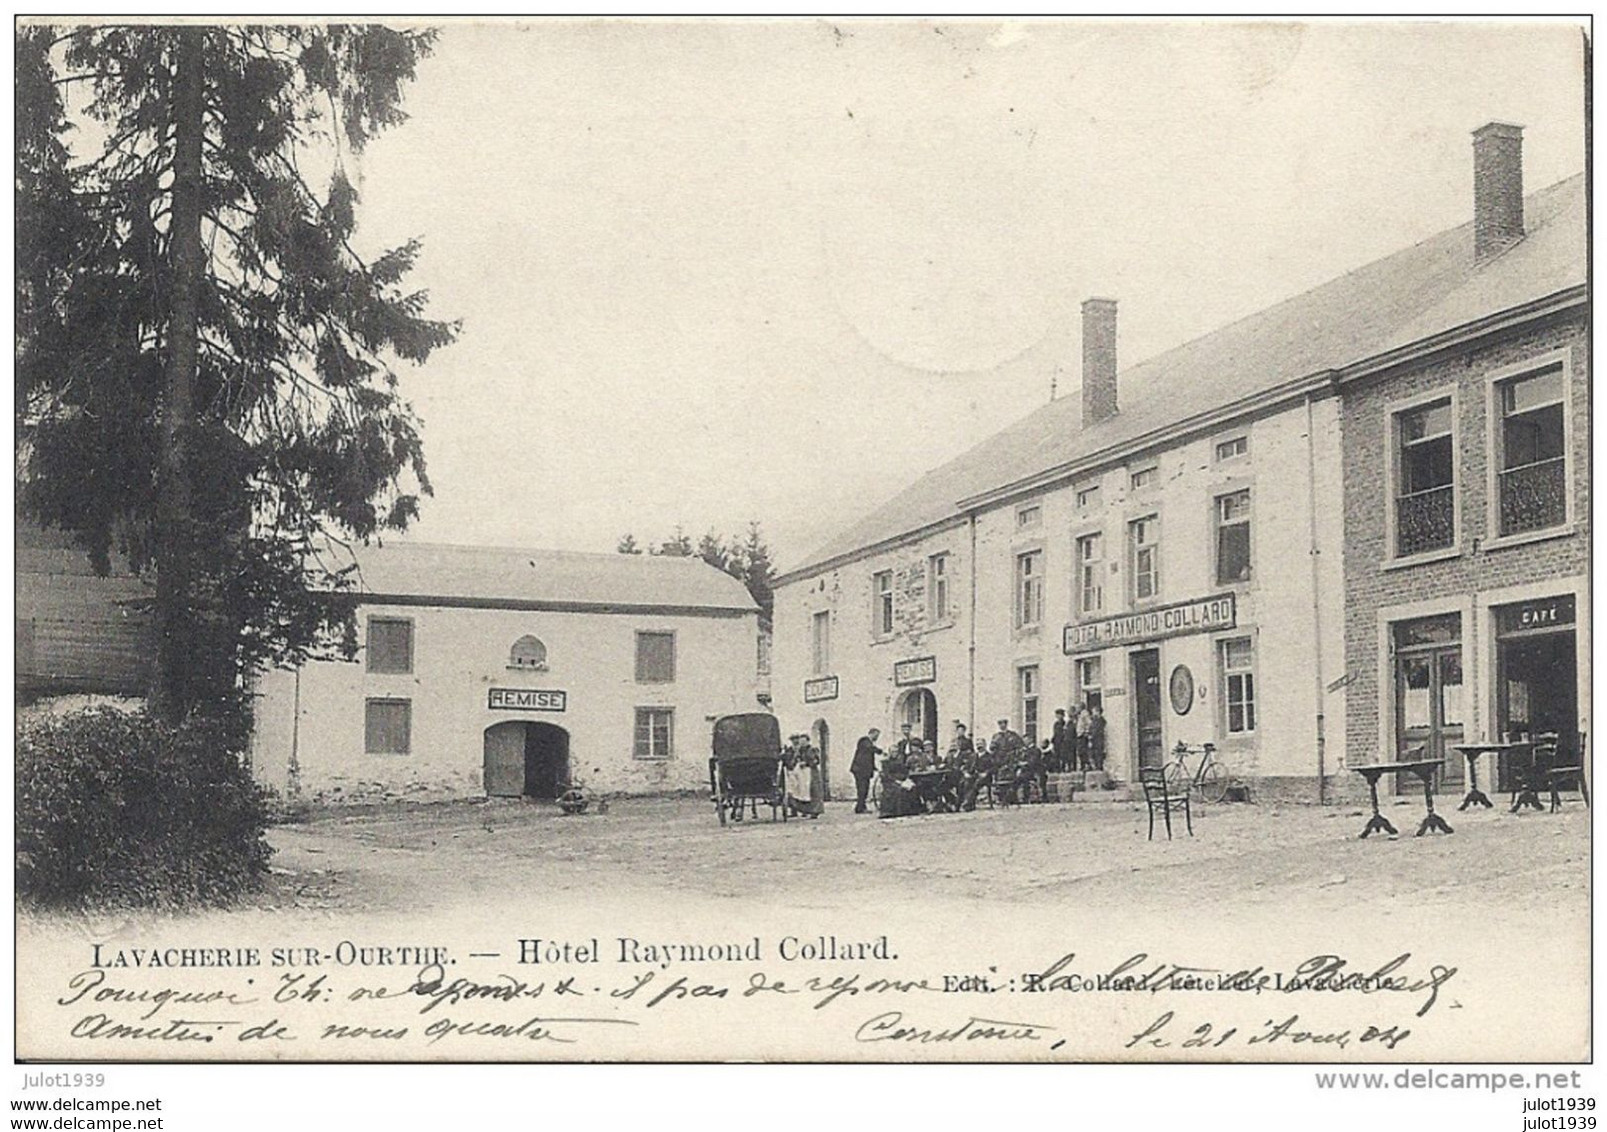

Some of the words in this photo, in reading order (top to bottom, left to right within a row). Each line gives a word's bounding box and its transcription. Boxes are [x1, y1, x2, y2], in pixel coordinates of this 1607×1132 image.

[1068, 625, 1101, 646] HOTEL
[1106, 614, 1158, 640] RAYMOND
[1164, 600, 1229, 629] COLLARD
[1522, 604, 1556, 623] CAFÉ
[493, 692, 560, 706] REMISE
[646, 977, 728, 1008] pas
